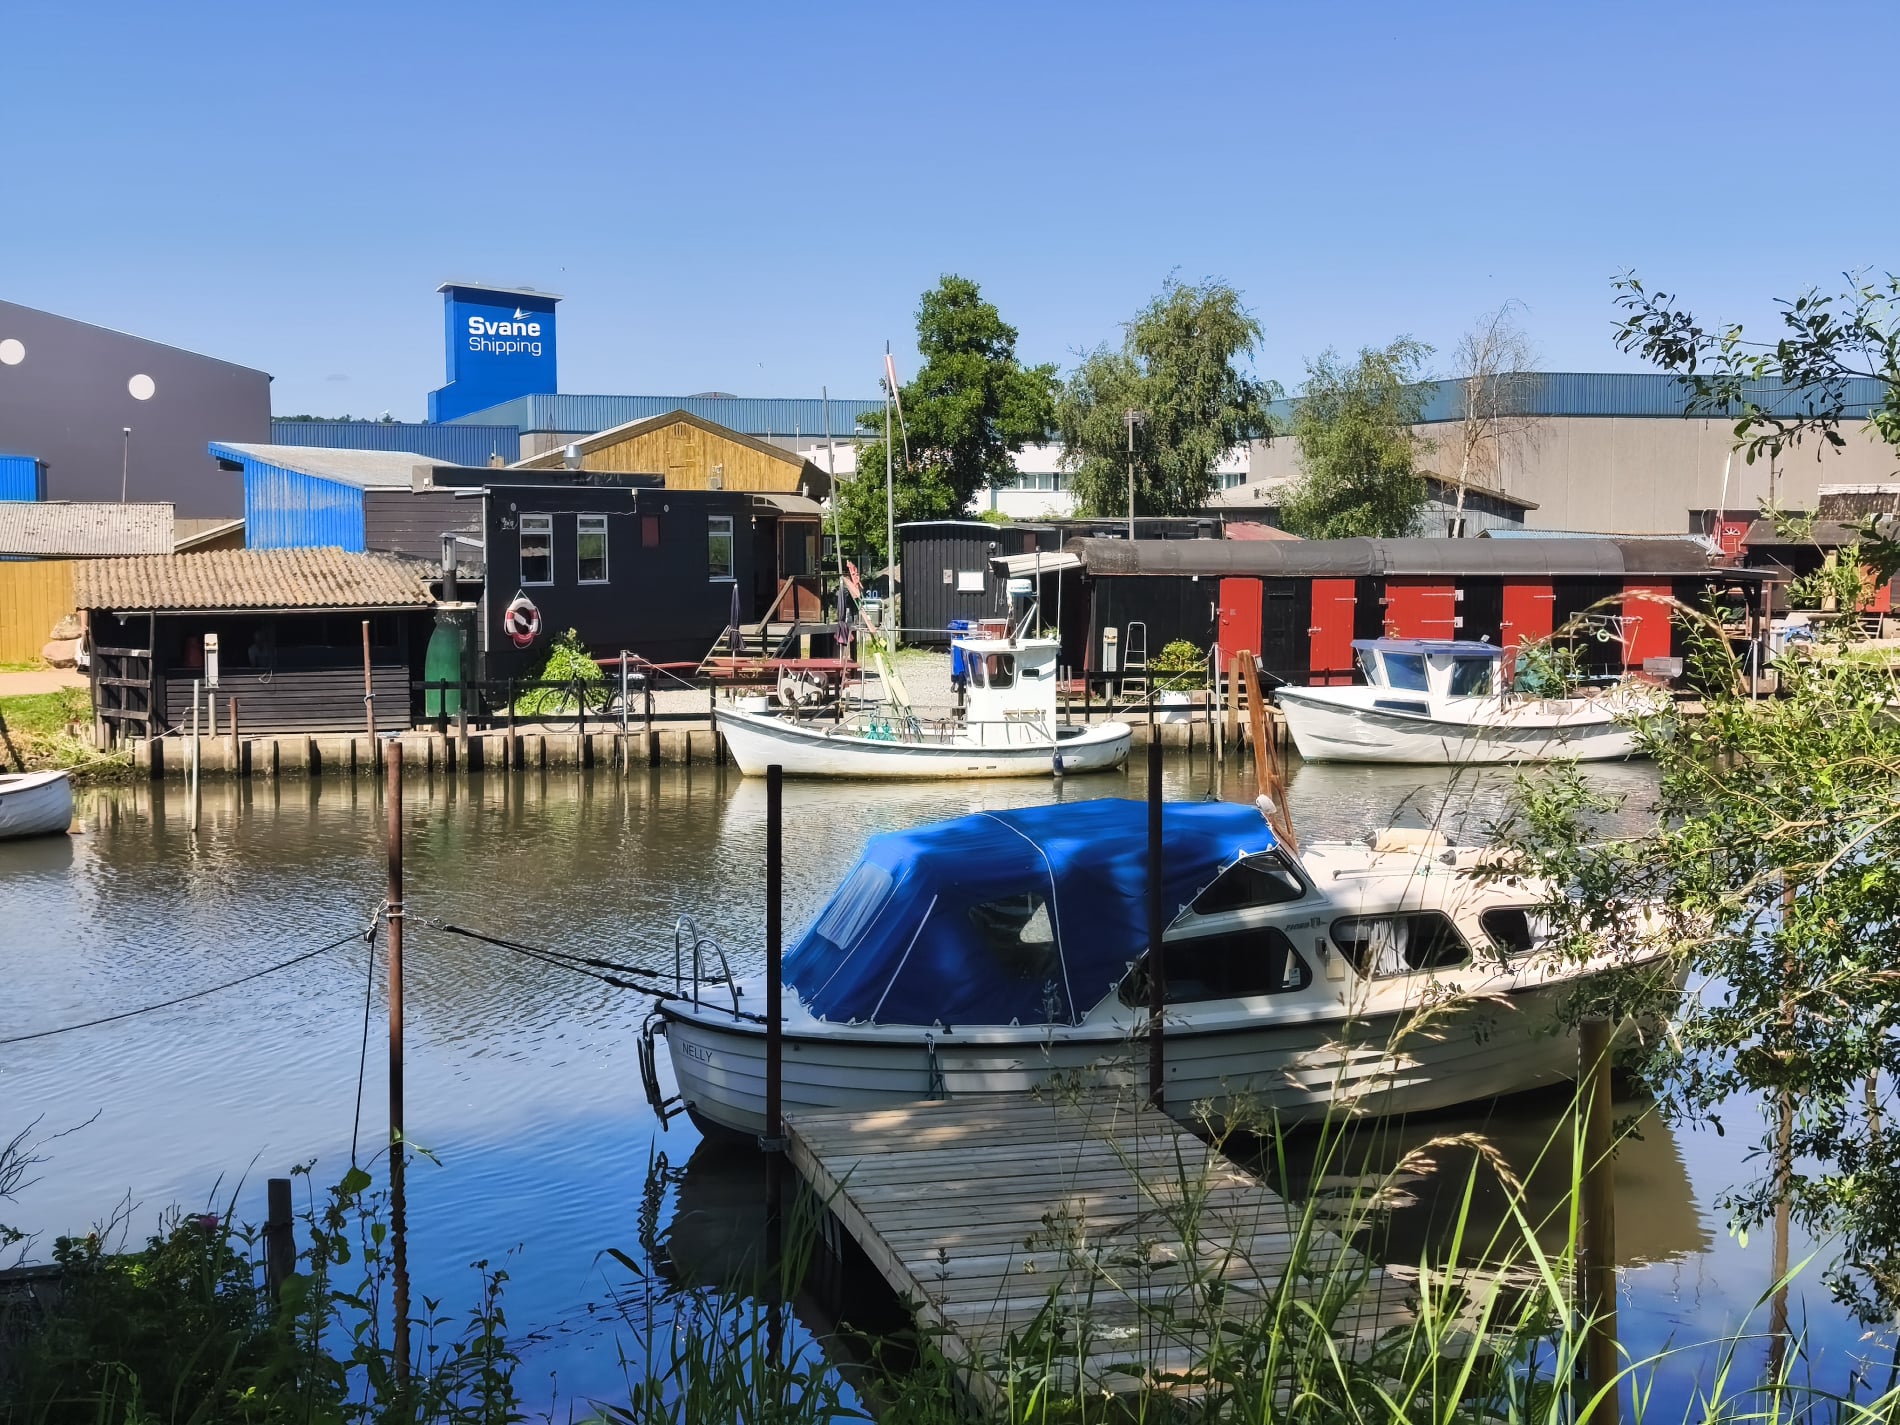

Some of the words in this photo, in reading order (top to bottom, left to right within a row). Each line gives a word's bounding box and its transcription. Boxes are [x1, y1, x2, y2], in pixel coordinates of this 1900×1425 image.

[468, 316, 541, 337] Svane
[469, 337, 542, 357] Shipping
[682, 1042, 713, 1063] NELLY
